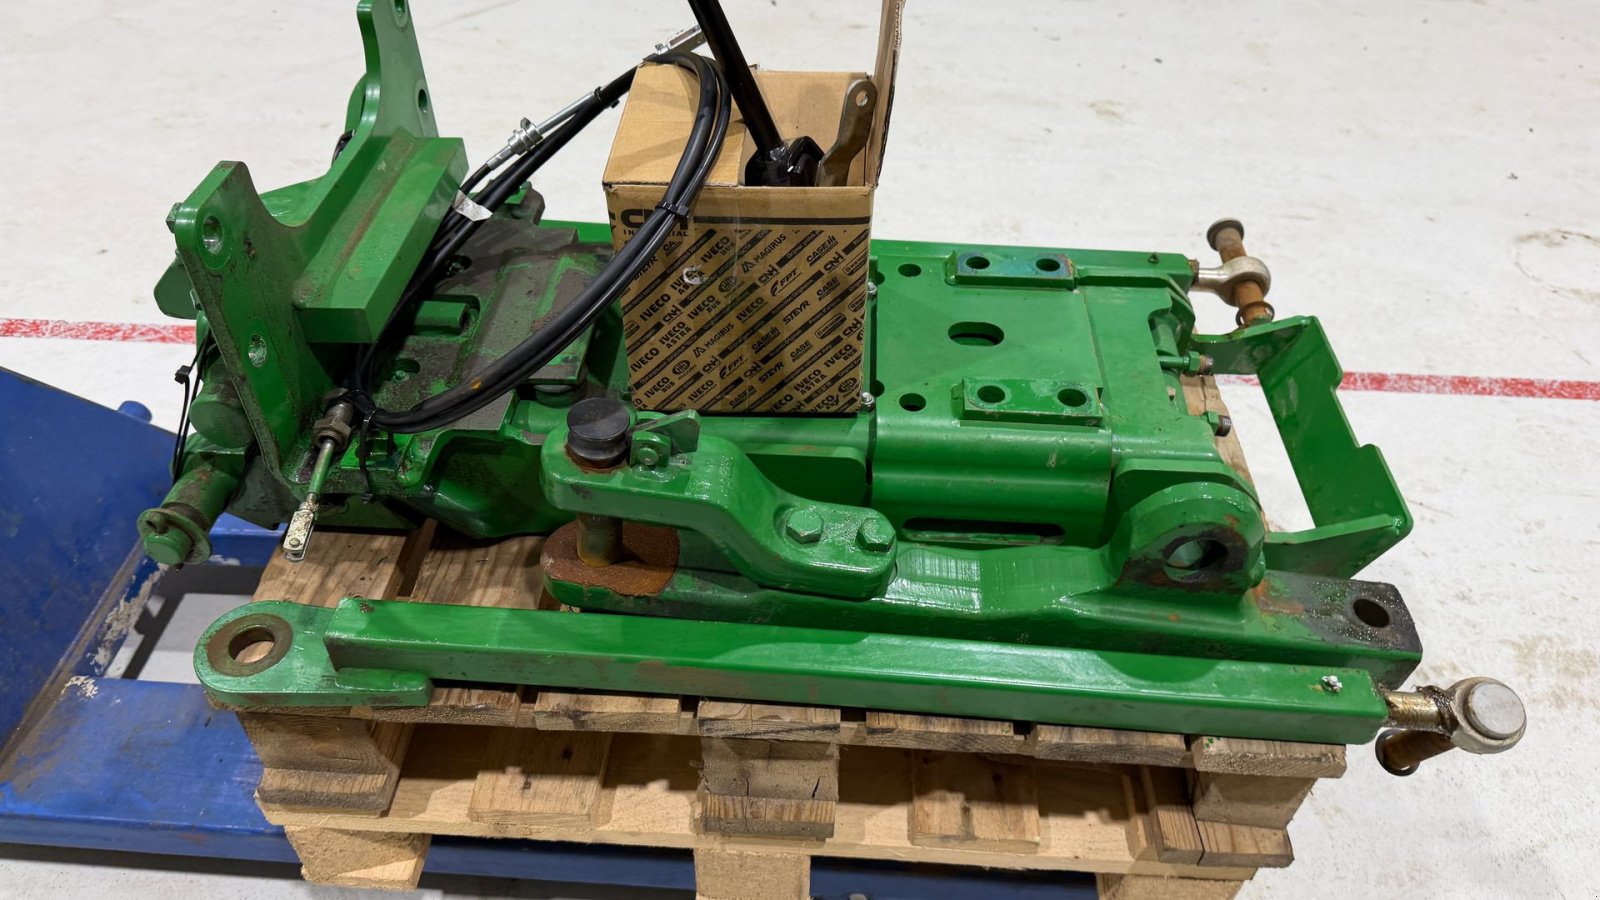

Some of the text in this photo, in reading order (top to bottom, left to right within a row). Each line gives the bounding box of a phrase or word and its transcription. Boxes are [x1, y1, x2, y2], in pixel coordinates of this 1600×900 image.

[700, 236, 731, 263] IVECO
[753, 233, 787, 263] MAGIRUS
[640, 293, 671, 321] IVECO
[687, 295, 716, 320] IVECO
[736, 296, 765, 321] IVECO
[783, 300, 811, 325] STEYR
[659, 321, 686, 345] IVECO
[665, 326, 692, 349] ASTRA
[704, 322, 735, 348] MAGIRUS
[630, 347, 660, 373] IVECO
[824, 343, 853, 368] IVECO
[758, 361, 785, 384] STEYR
[794, 369, 822, 392] IVECO
[800, 373, 827, 395] ASTRA
[643, 376, 670, 398] IVECO
[688, 379, 714, 401] IVECO
